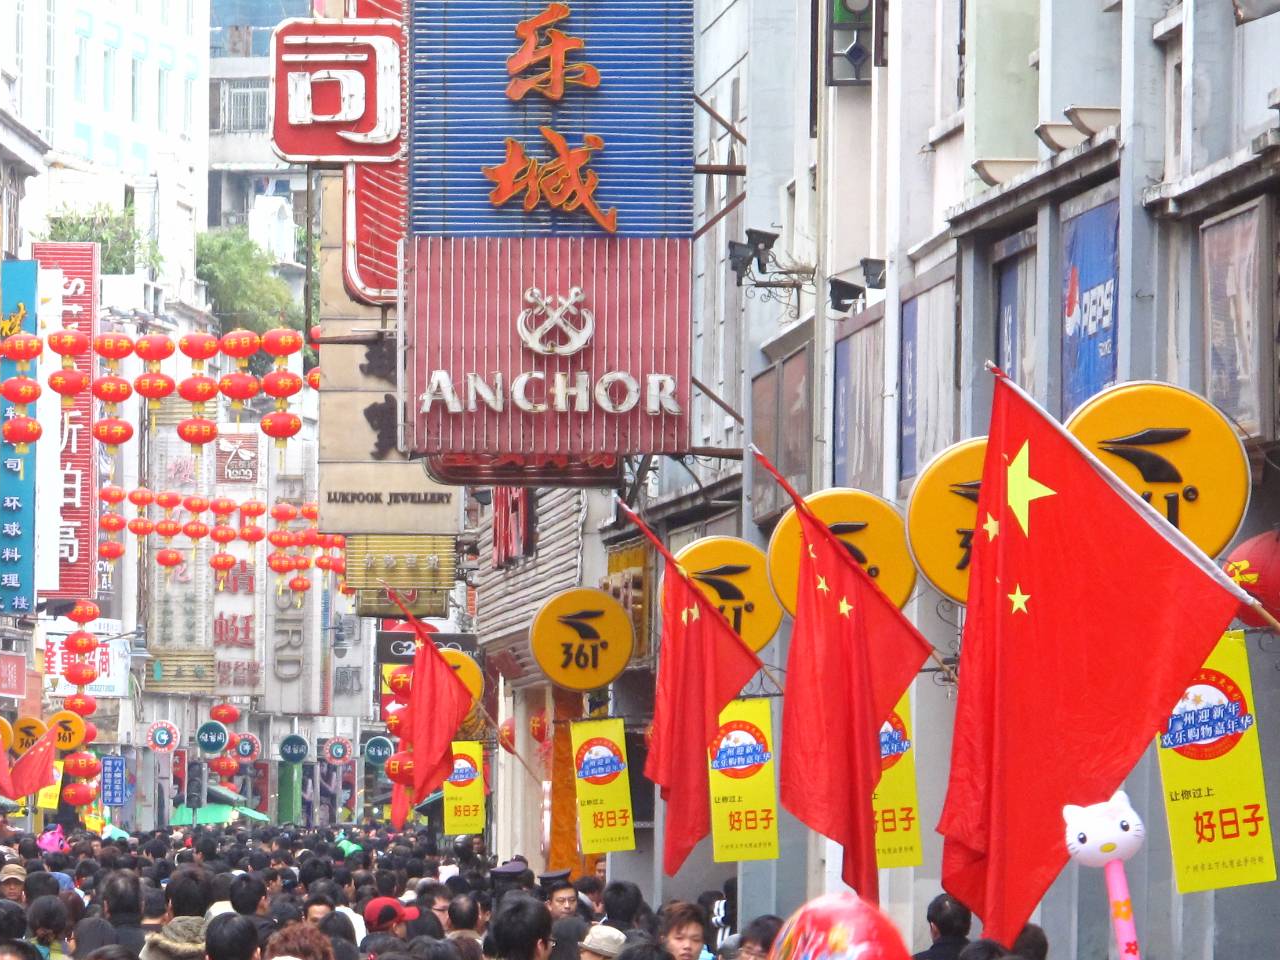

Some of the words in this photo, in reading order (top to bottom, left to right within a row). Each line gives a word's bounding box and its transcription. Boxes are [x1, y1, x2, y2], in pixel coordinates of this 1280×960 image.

[419, 369, 684, 417] ANCHOR
[386, 491, 453, 506] JEWELLERY
[560, 640, 609, 669] 361°
[1168, 702, 1241, 731] 广州迎新年
[1161, 715, 1254, 746] 欢乐购物嘉年华
[1170, 786, 1215, 802] 让你过上
[454, 804, 480, 817] 好日子
[593, 809, 630, 829] 好日子
[728, 809, 774, 832] 好日子
[1194, 804, 1264, 844] 好日子
